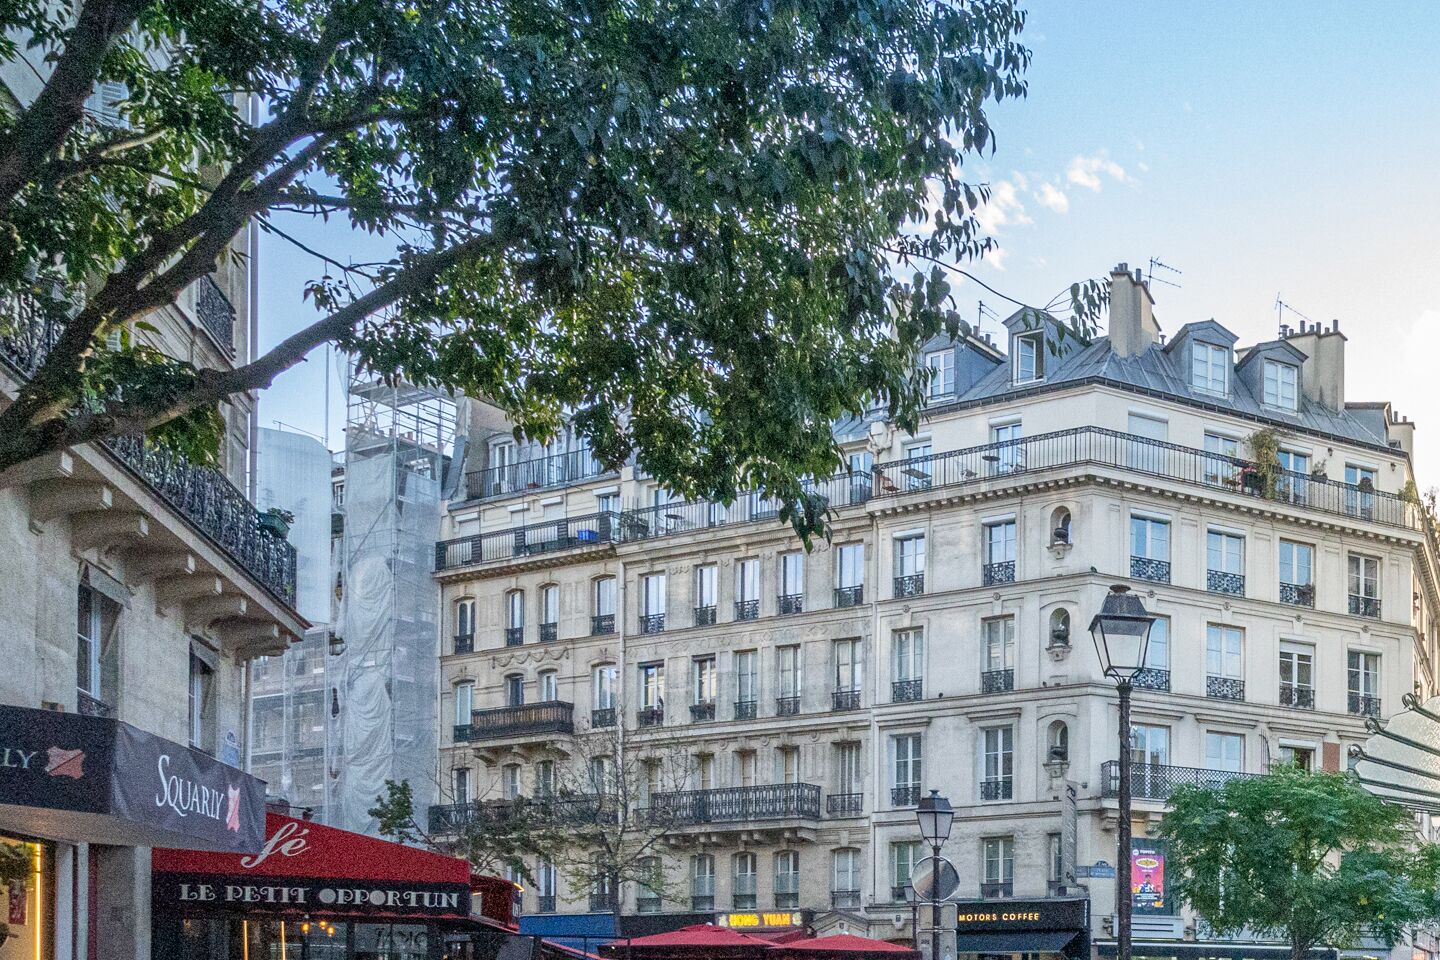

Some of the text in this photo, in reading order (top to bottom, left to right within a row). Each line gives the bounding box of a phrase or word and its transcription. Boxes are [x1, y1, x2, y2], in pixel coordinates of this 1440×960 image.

[0, 747, 39, 769] LY
[155, 754, 225, 820] SQUARLY
[180, 884, 459, 908] LE PETIT OPPORTUN
[763, 913, 791, 926] YUAN
[958, 912, 1040, 922] MOTORS COFFEE
